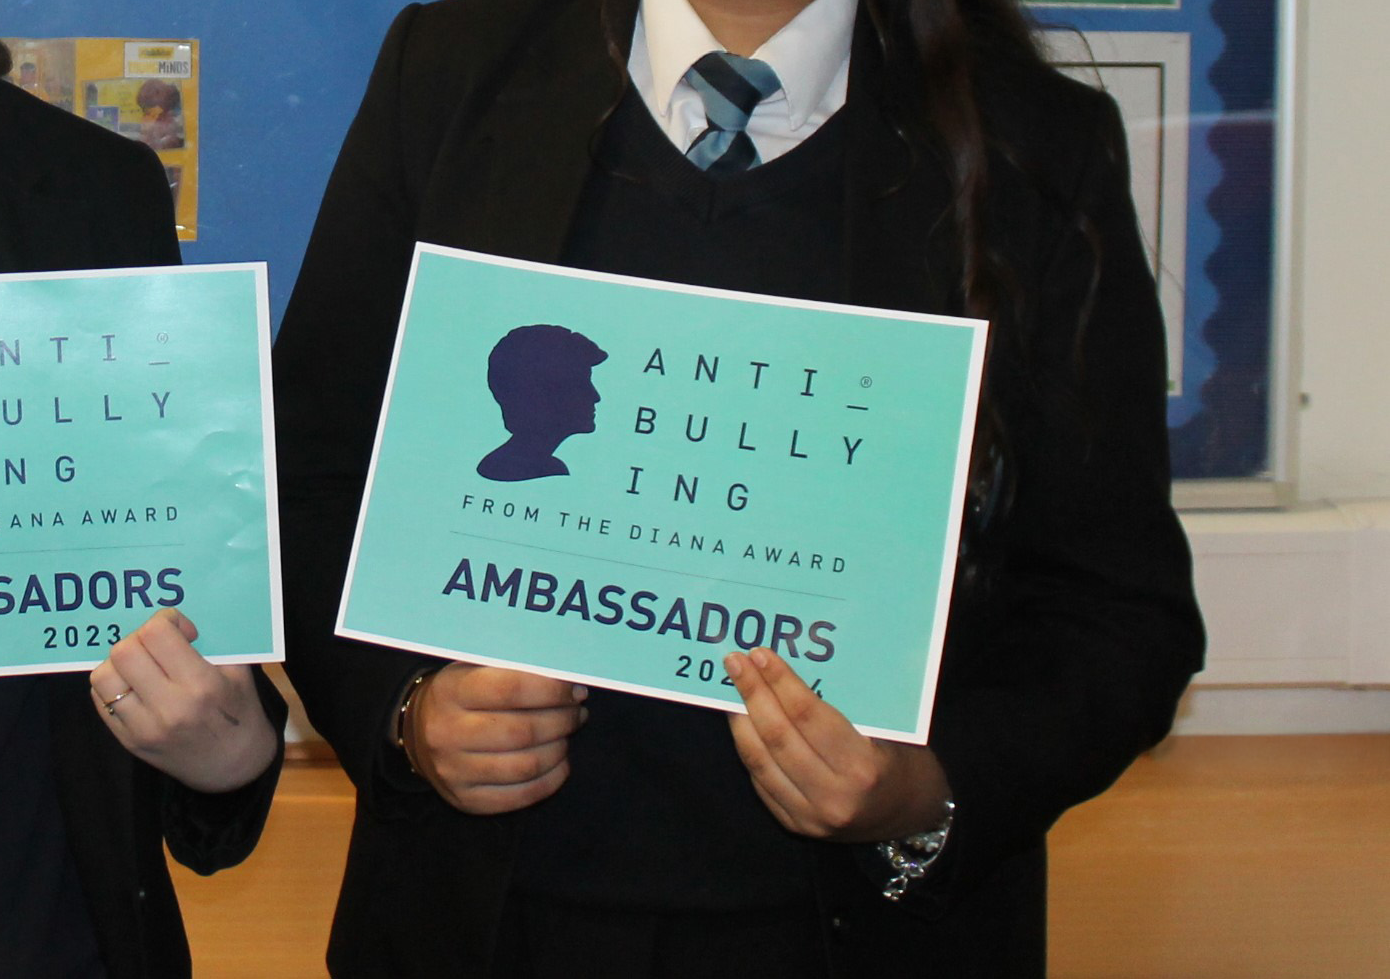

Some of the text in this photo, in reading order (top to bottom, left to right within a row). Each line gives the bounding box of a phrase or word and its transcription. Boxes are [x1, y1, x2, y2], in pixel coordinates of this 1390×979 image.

[634, 406, 863, 466] BULLY
[82, 506, 180, 527] AWARD
[626, 467, 750, 512] ING
[462, 494, 847, 575] FROM THE DIANA AWARD
[442, 557, 838, 664] AMBASSADORS
